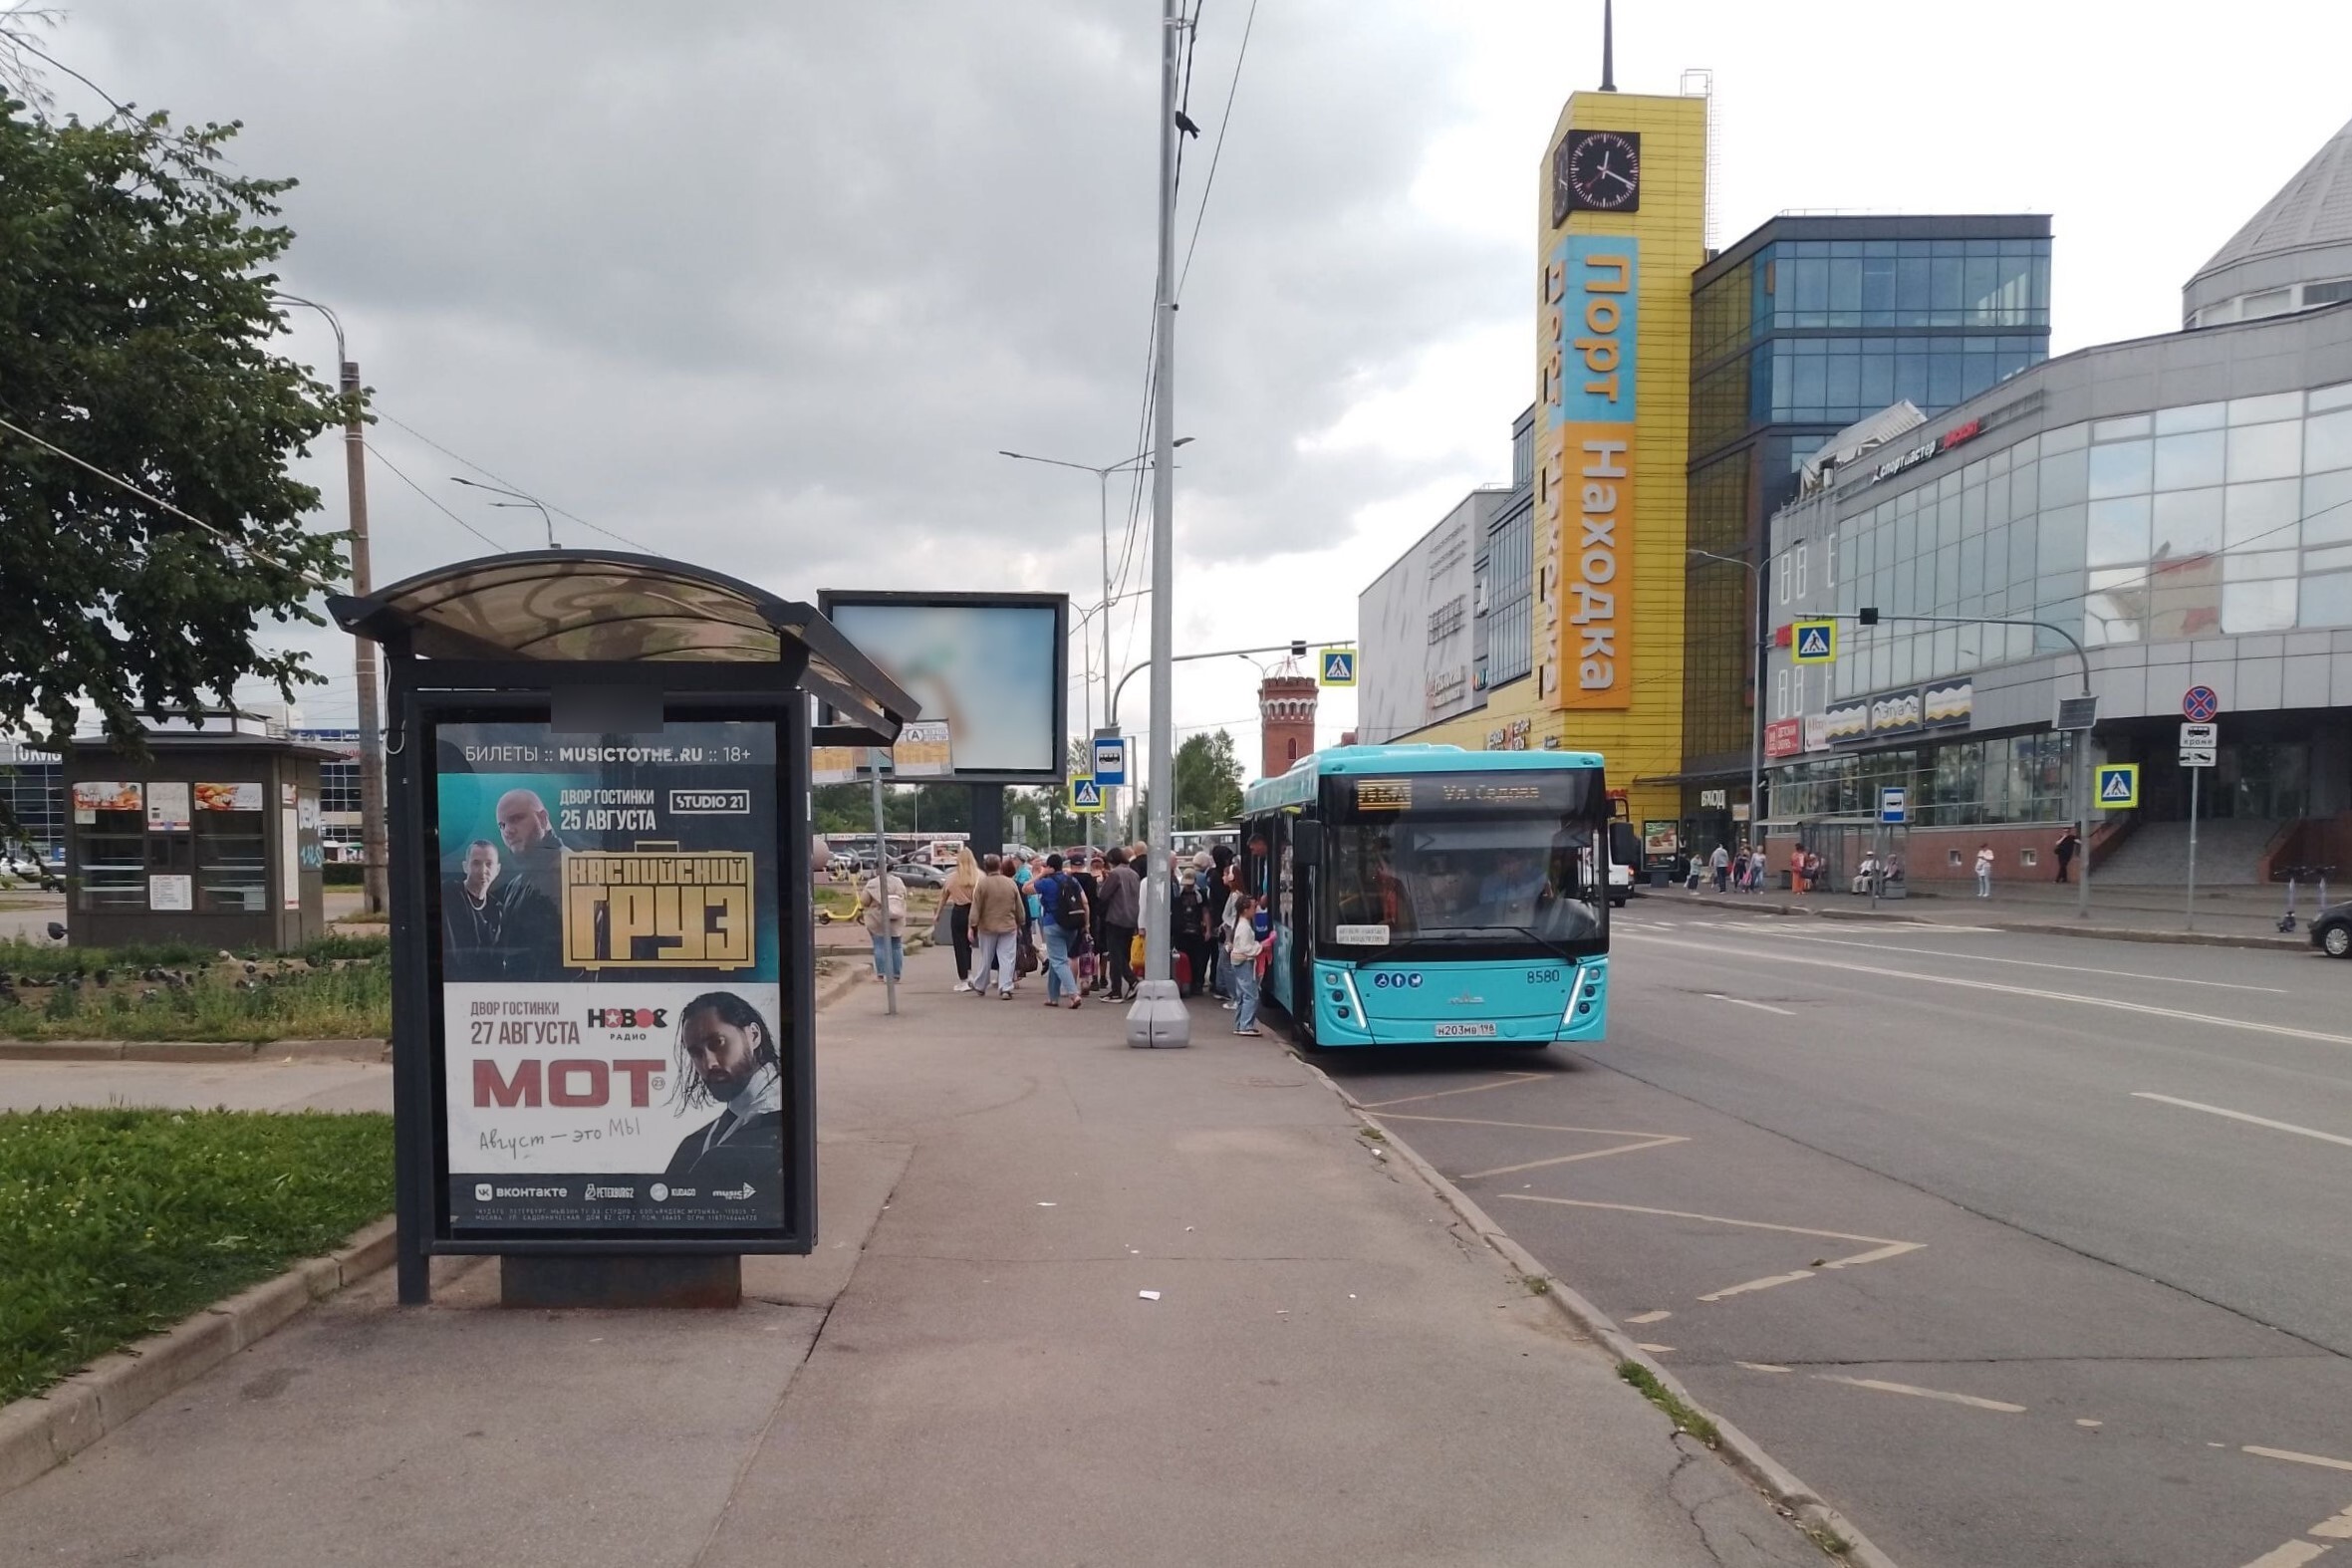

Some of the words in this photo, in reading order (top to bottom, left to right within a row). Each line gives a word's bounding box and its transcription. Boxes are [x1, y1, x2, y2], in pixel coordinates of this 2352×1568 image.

[1575, 254, 1631, 403] Порт
[1570, 440, 1628, 690] Находка
[465, 746, 539, 762] БИЛЕТЫ
[559, 746, 703, 762] MUSICTOTHE.RU
[723, 747, 751, 762] 18+
[560, 790, 592, 806] ДВОР
[595, 790, 654, 806] ГОСТИНКИ
[675, 795, 727, 809] STUDIO
[730, 796, 744, 809] 21
[1700, 789, 1726, 810] ВХОД
[560, 810, 582, 831] 25
[585, 810, 656, 831] АВГУСТА
[570, 858, 746, 884] КАСПИЙСКИЙ
[570, 886, 747, 960] ГРУЗ
[1526, 969, 1560, 984] 8580
[470, 1001, 501, 1016] ДВОР
[503, 1001, 560, 1016] ГОСТИНКИ
[470, 1021, 494, 1045] 27
[499, 1021, 581, 1045] АВГУСТА
[472, 1059, 666, 1109] МОТ
[479, 1128, 545, 1161] Август
[572, 1129, 602, 1144] это
[495, 1186, 568, 1197] вконтакте
